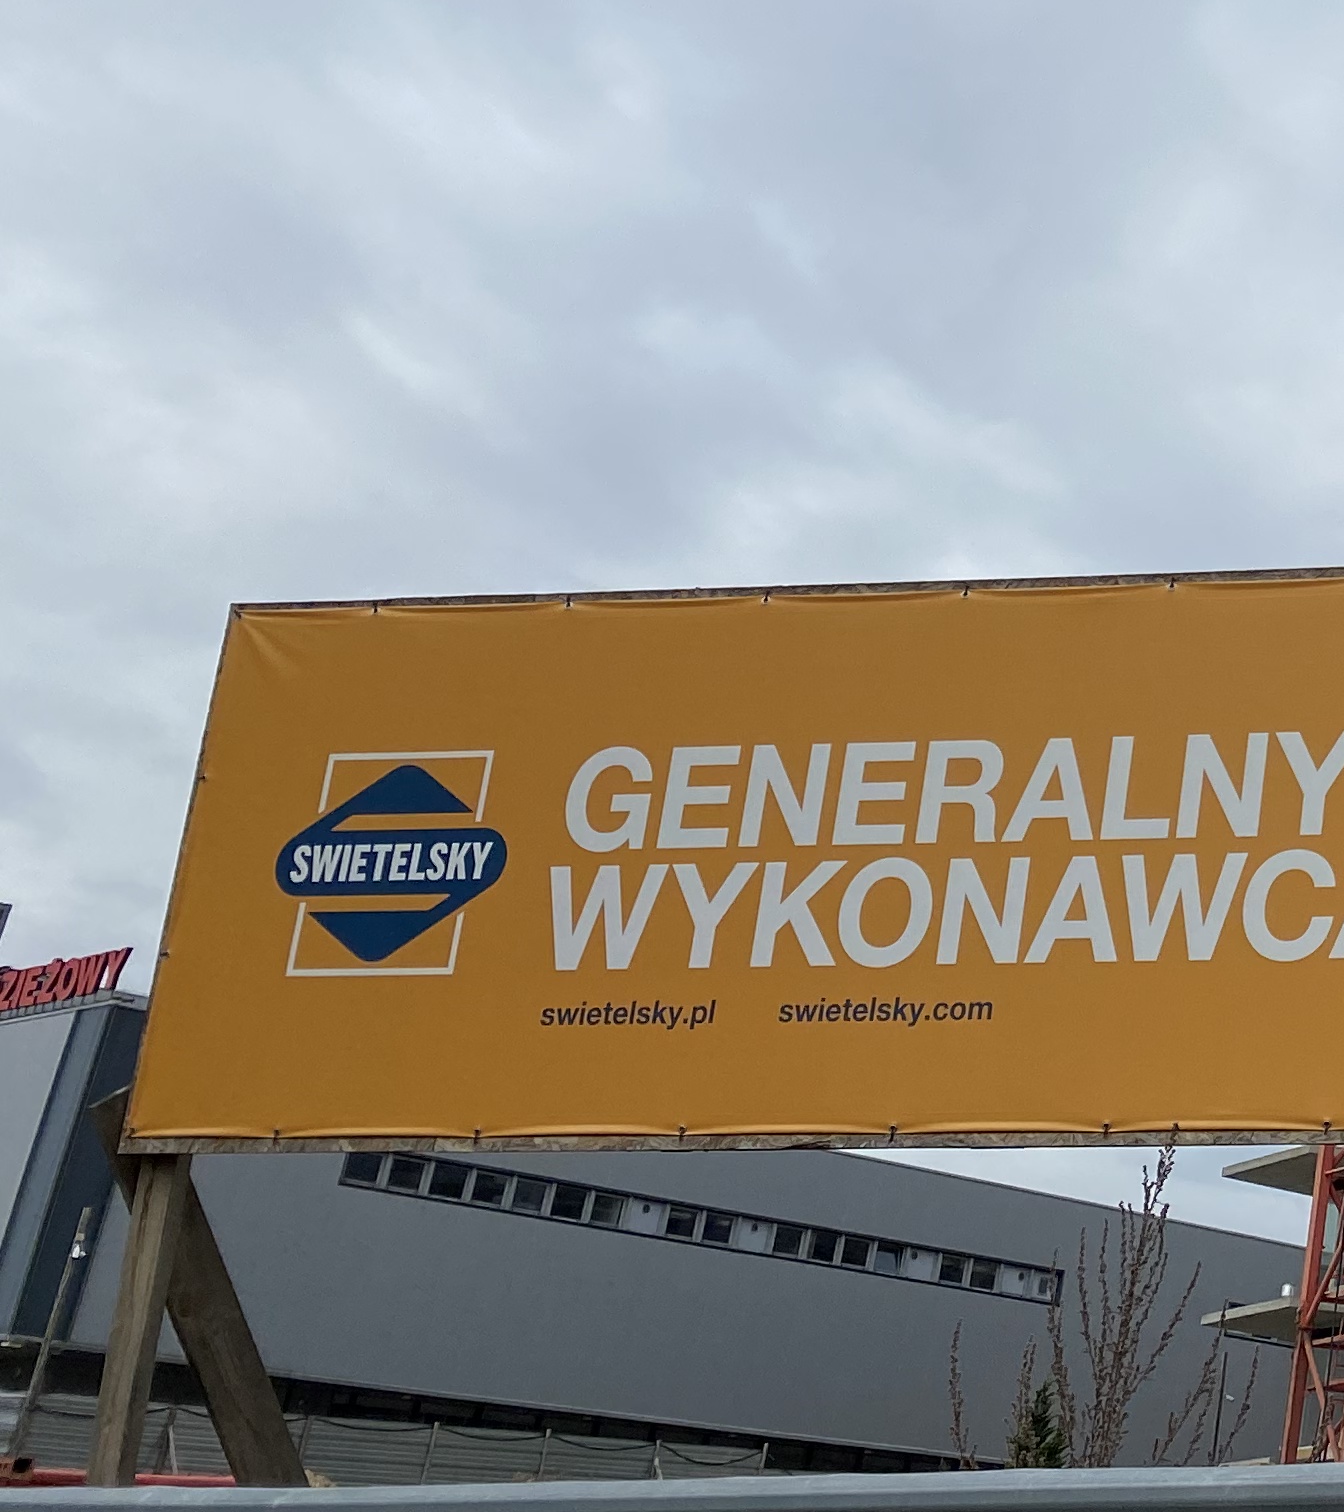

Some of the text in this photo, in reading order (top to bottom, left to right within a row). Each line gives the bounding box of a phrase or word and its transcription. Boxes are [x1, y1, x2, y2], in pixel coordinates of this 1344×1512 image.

[289, 841, 494, 883] SWIETELSKY
[540, 996, 994, 1030] swietelsky.pl swietelsky.com
